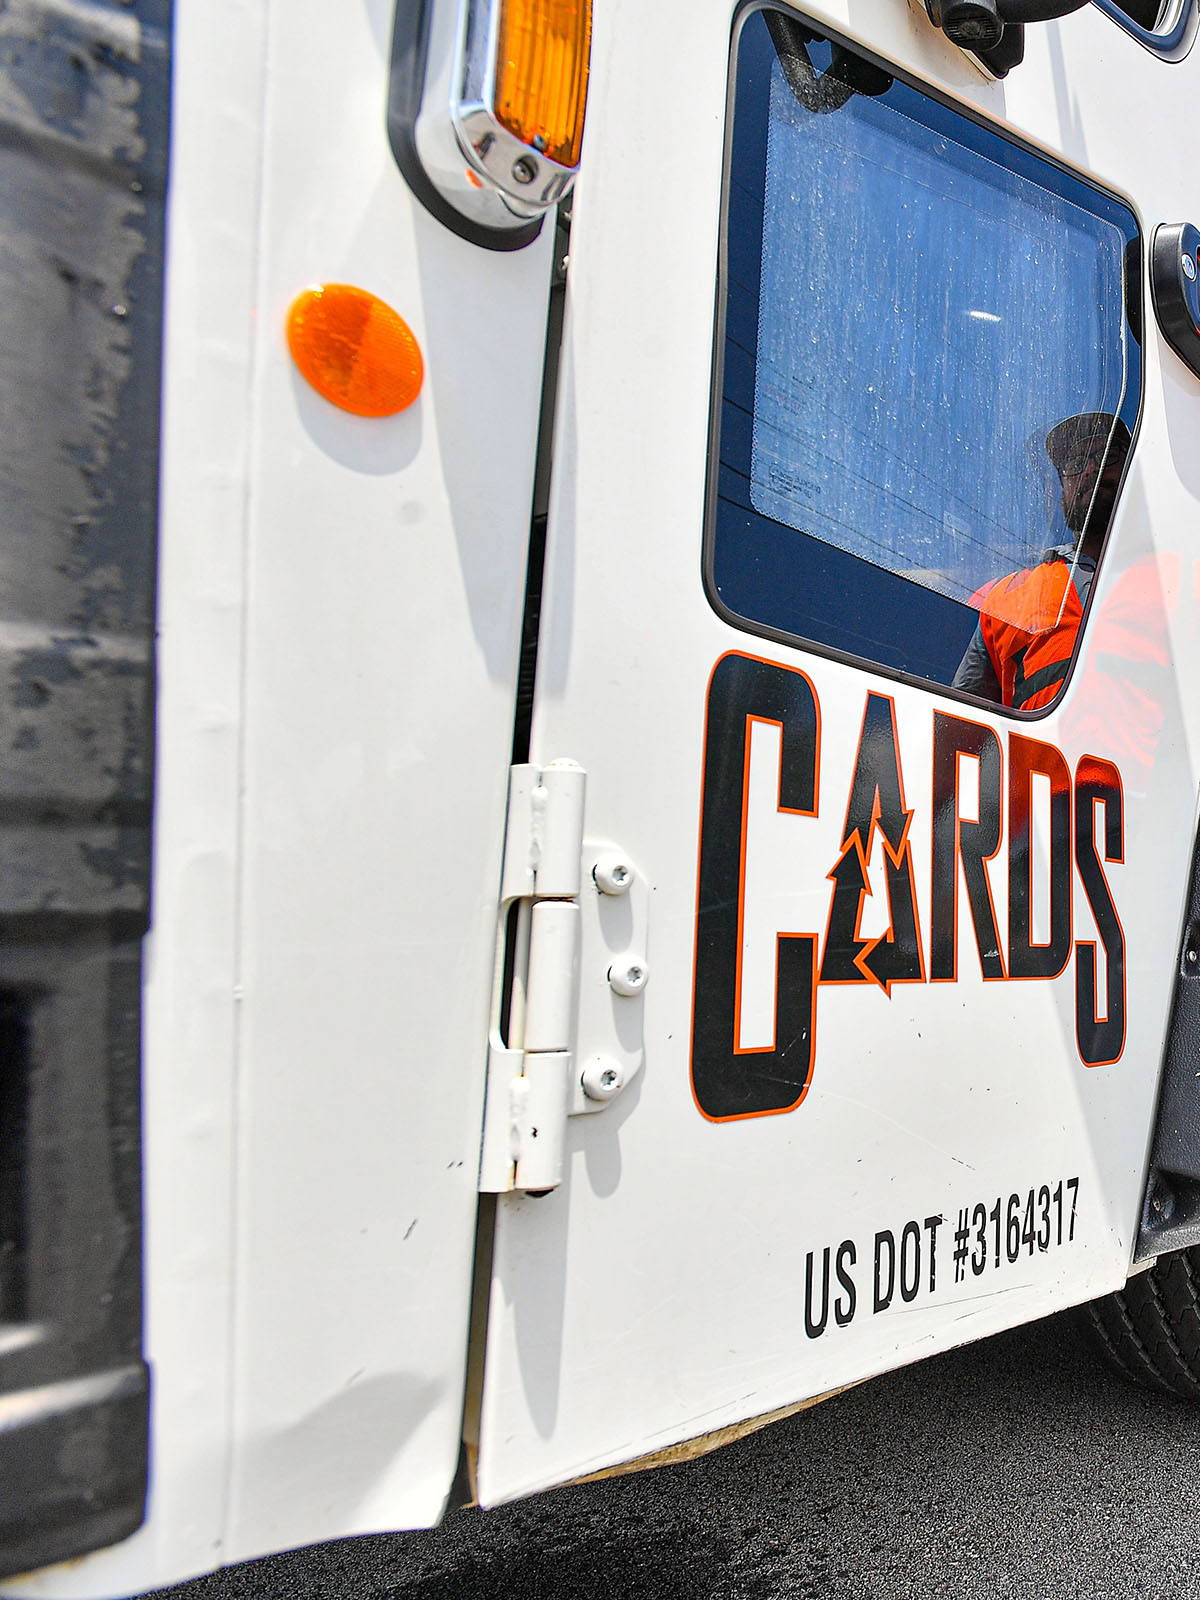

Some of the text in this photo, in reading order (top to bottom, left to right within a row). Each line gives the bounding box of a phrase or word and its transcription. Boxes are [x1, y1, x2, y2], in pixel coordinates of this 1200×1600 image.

[689, 649, 1126, 1124] CARDS
[804, 1176, 1079, 1339] US DOT #3164317
